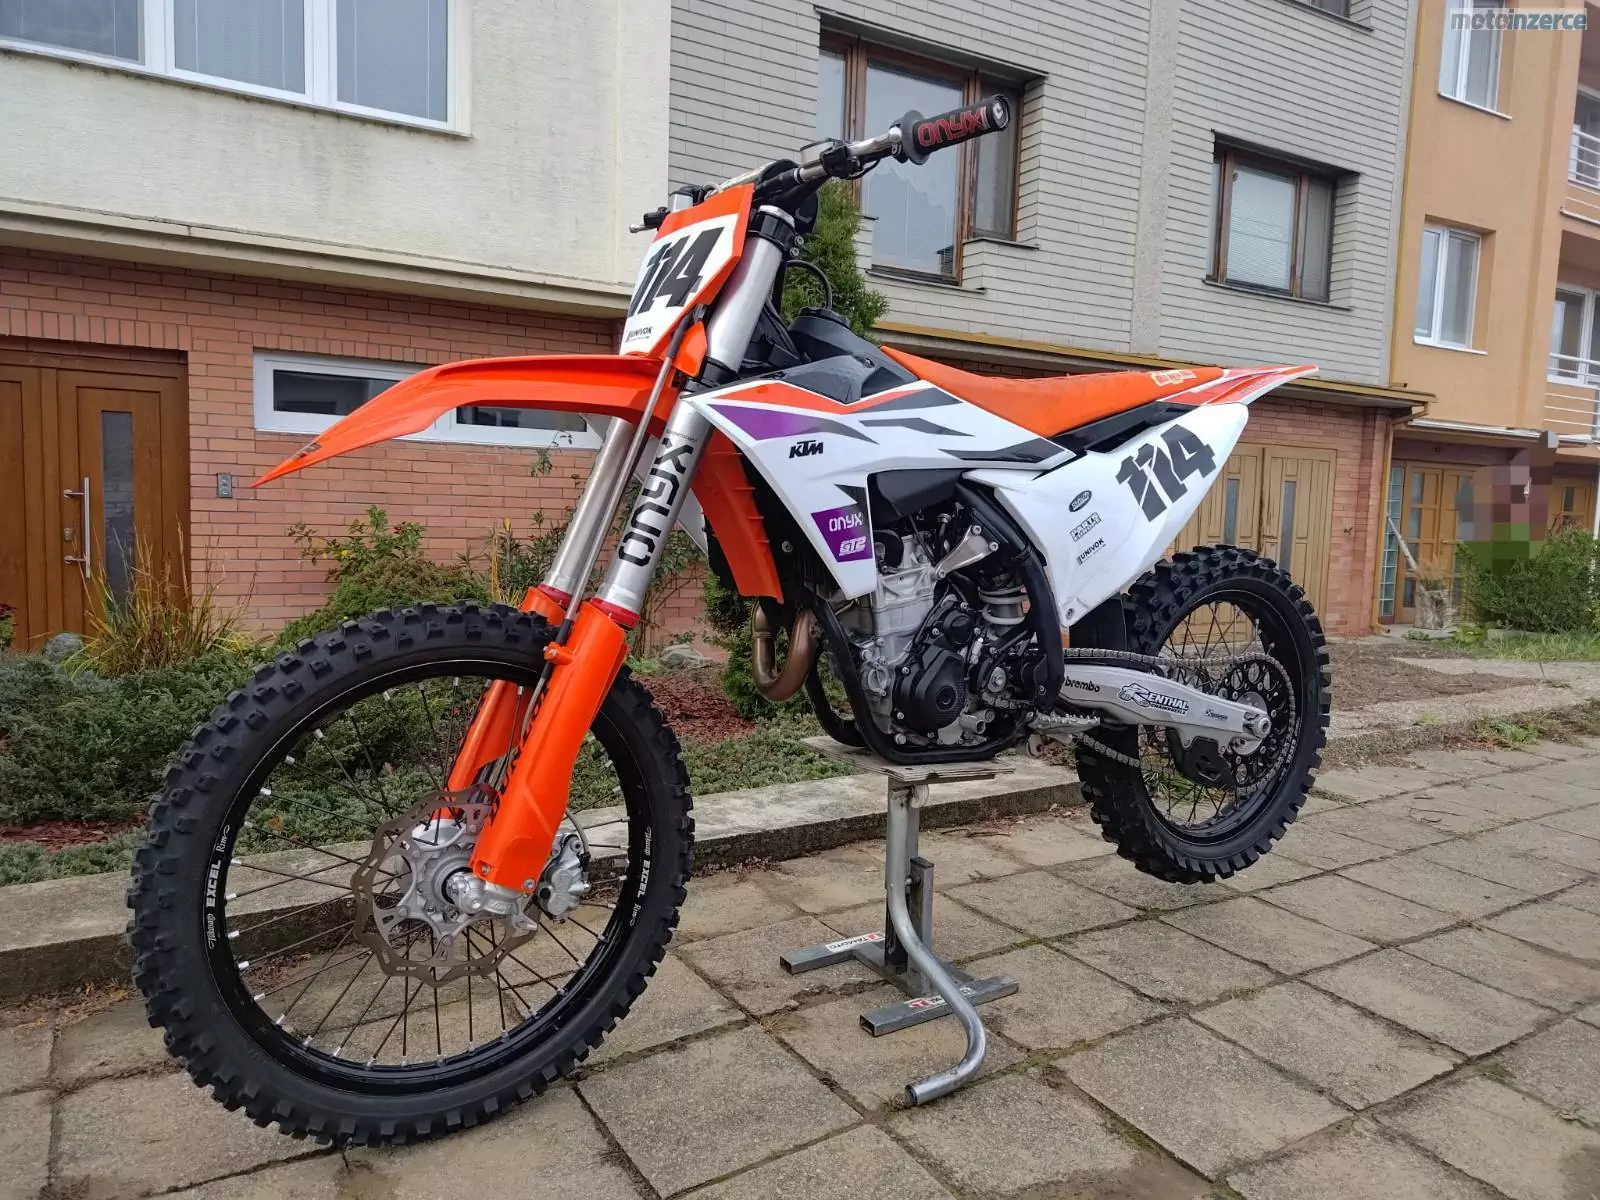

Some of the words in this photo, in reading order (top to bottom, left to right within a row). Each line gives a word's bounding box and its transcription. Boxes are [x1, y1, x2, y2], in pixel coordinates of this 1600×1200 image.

[627, 226, 725, 319] 114
[788, 439, 824, 459] KTM
[1115, 423, 1217, 523] 114
[1079, 536, 1105, 562] UNIVOK
[1064, 675, 1101, 693] brembo
[1117, 682, 1190, 711] RENTHAL
[205, 859, 222, 908] EXCEL
[215, 824, 231, 853] Rim
[636, 859, 651, 899] EXCEL
